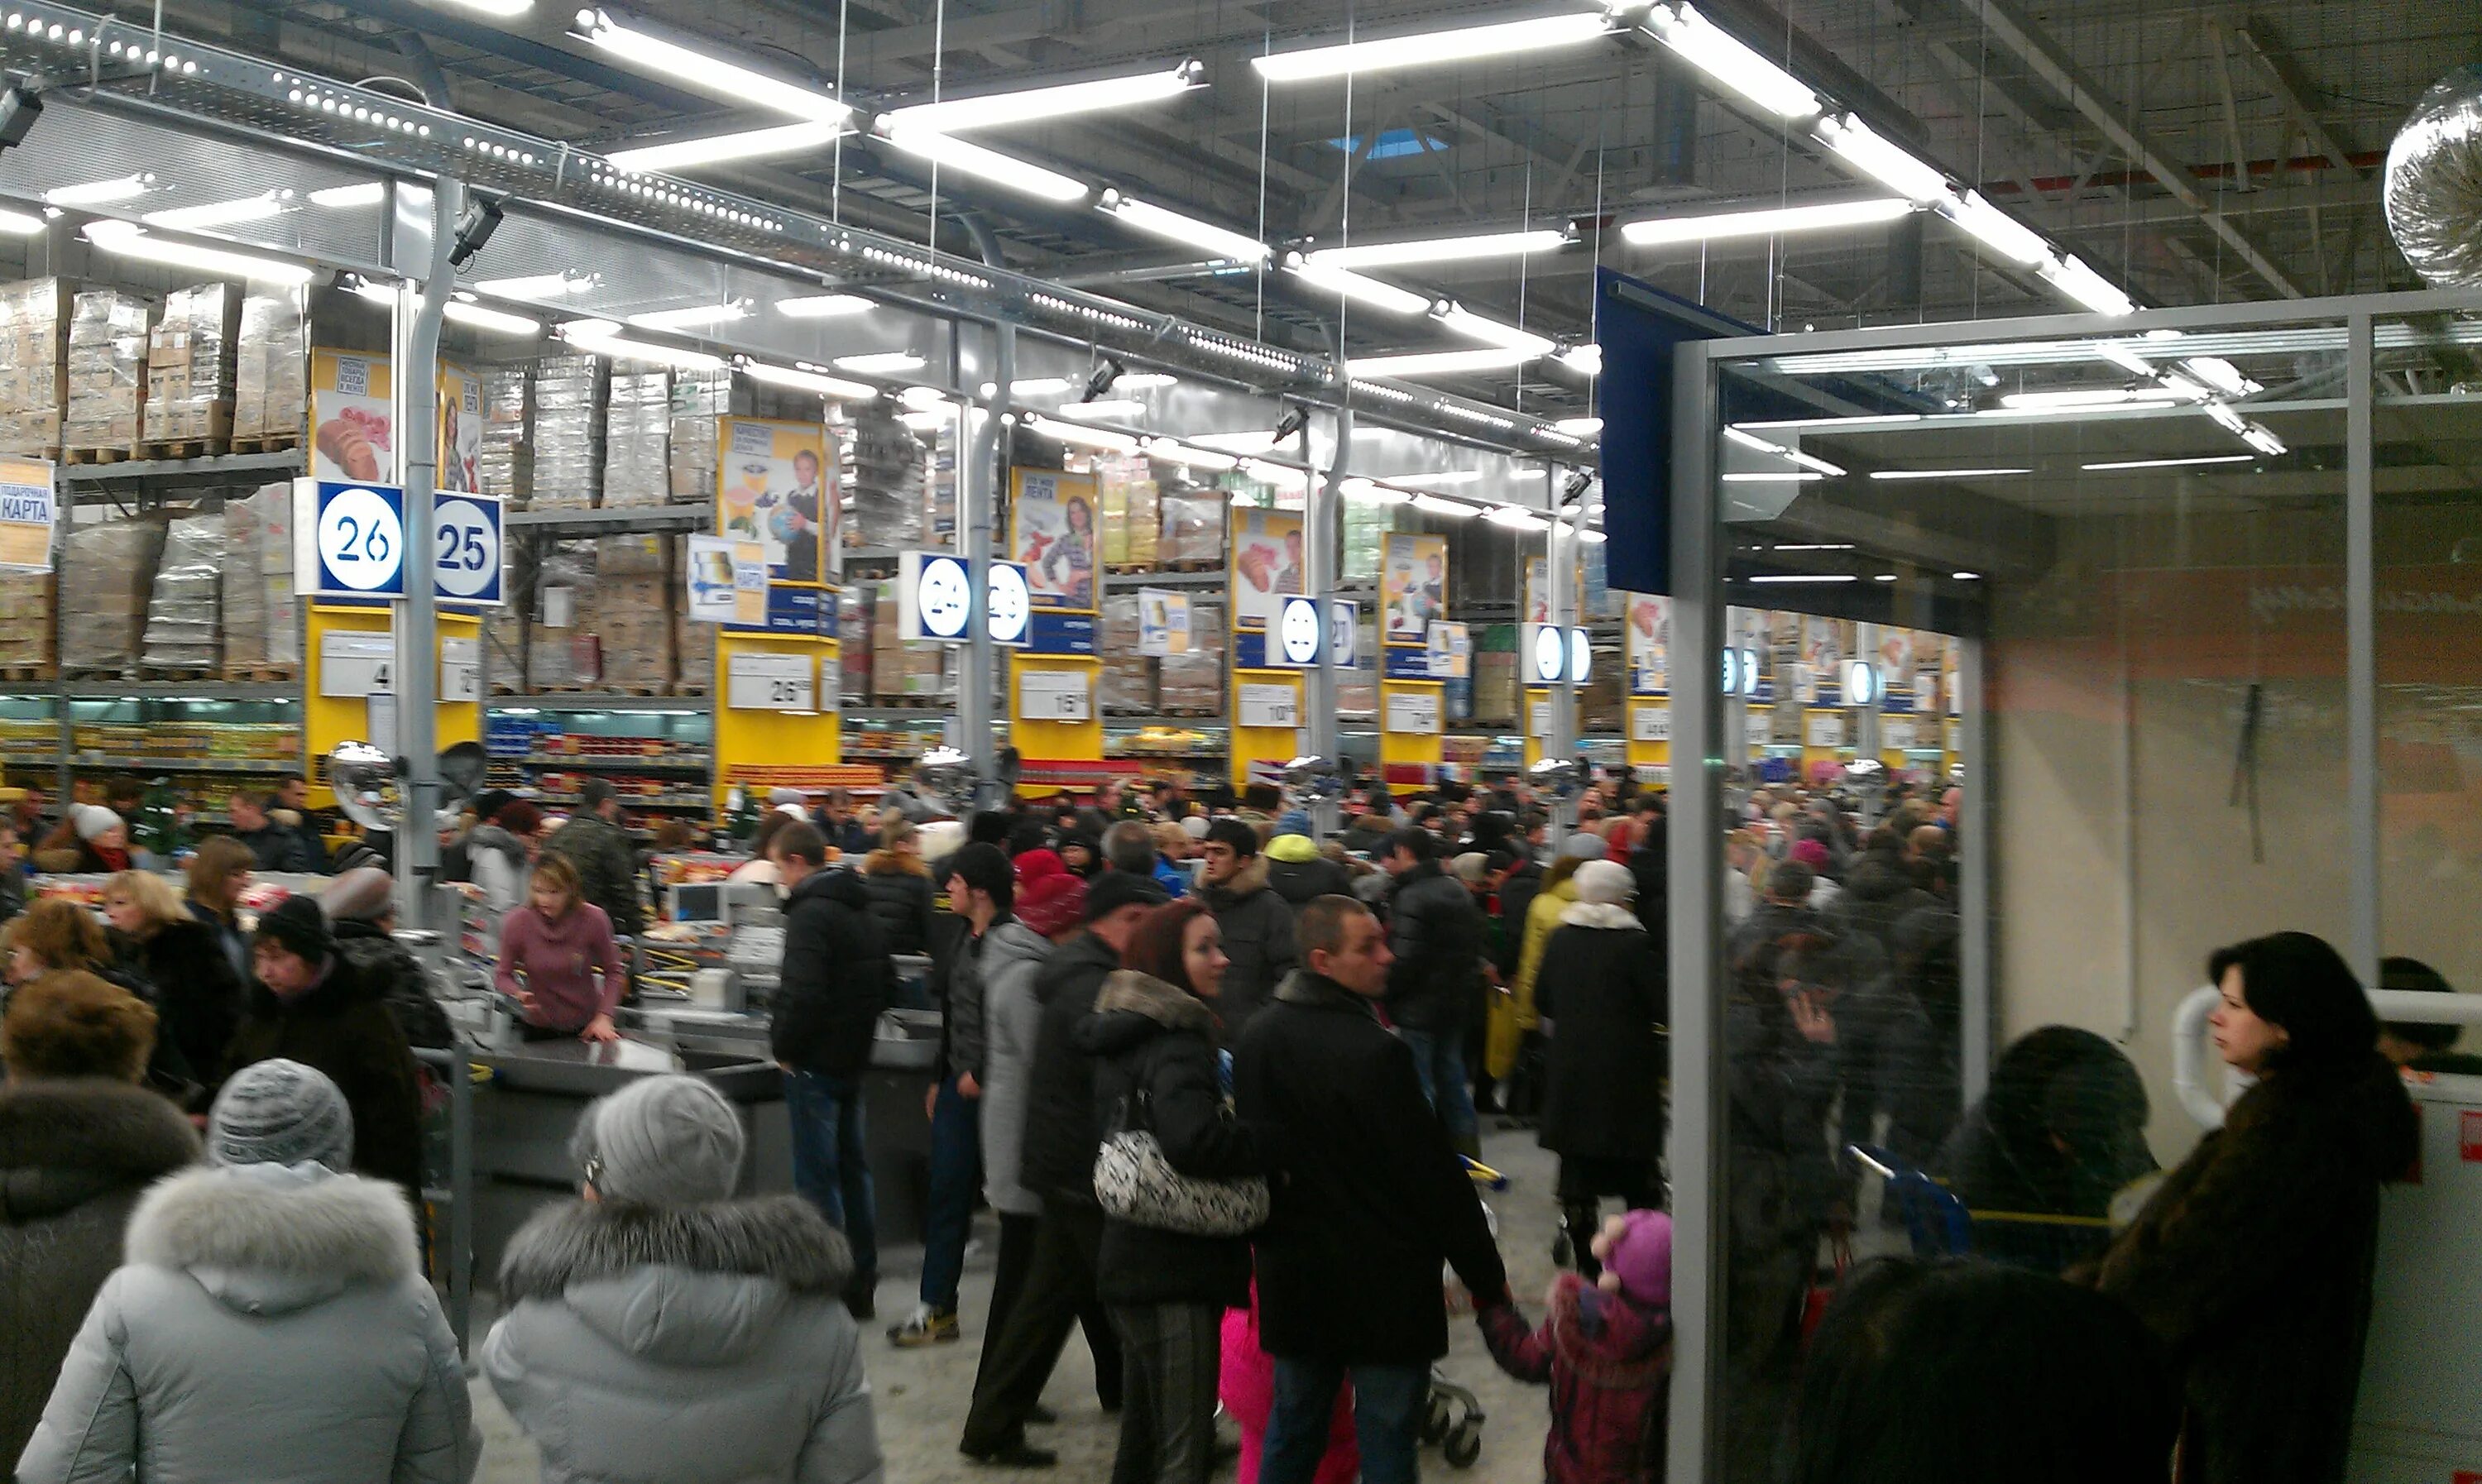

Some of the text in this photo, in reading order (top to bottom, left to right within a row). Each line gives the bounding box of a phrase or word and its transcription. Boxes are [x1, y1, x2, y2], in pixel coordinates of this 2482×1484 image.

[341, 375, 364, 385] ВСЕГДА
[2, 486, 47, 498] ПОДАРОЧНАЯ
[2, 498, 47, 520] КАРТА
[337, 516, 389, 561] 26
[437, 524, 485, 571] 25
